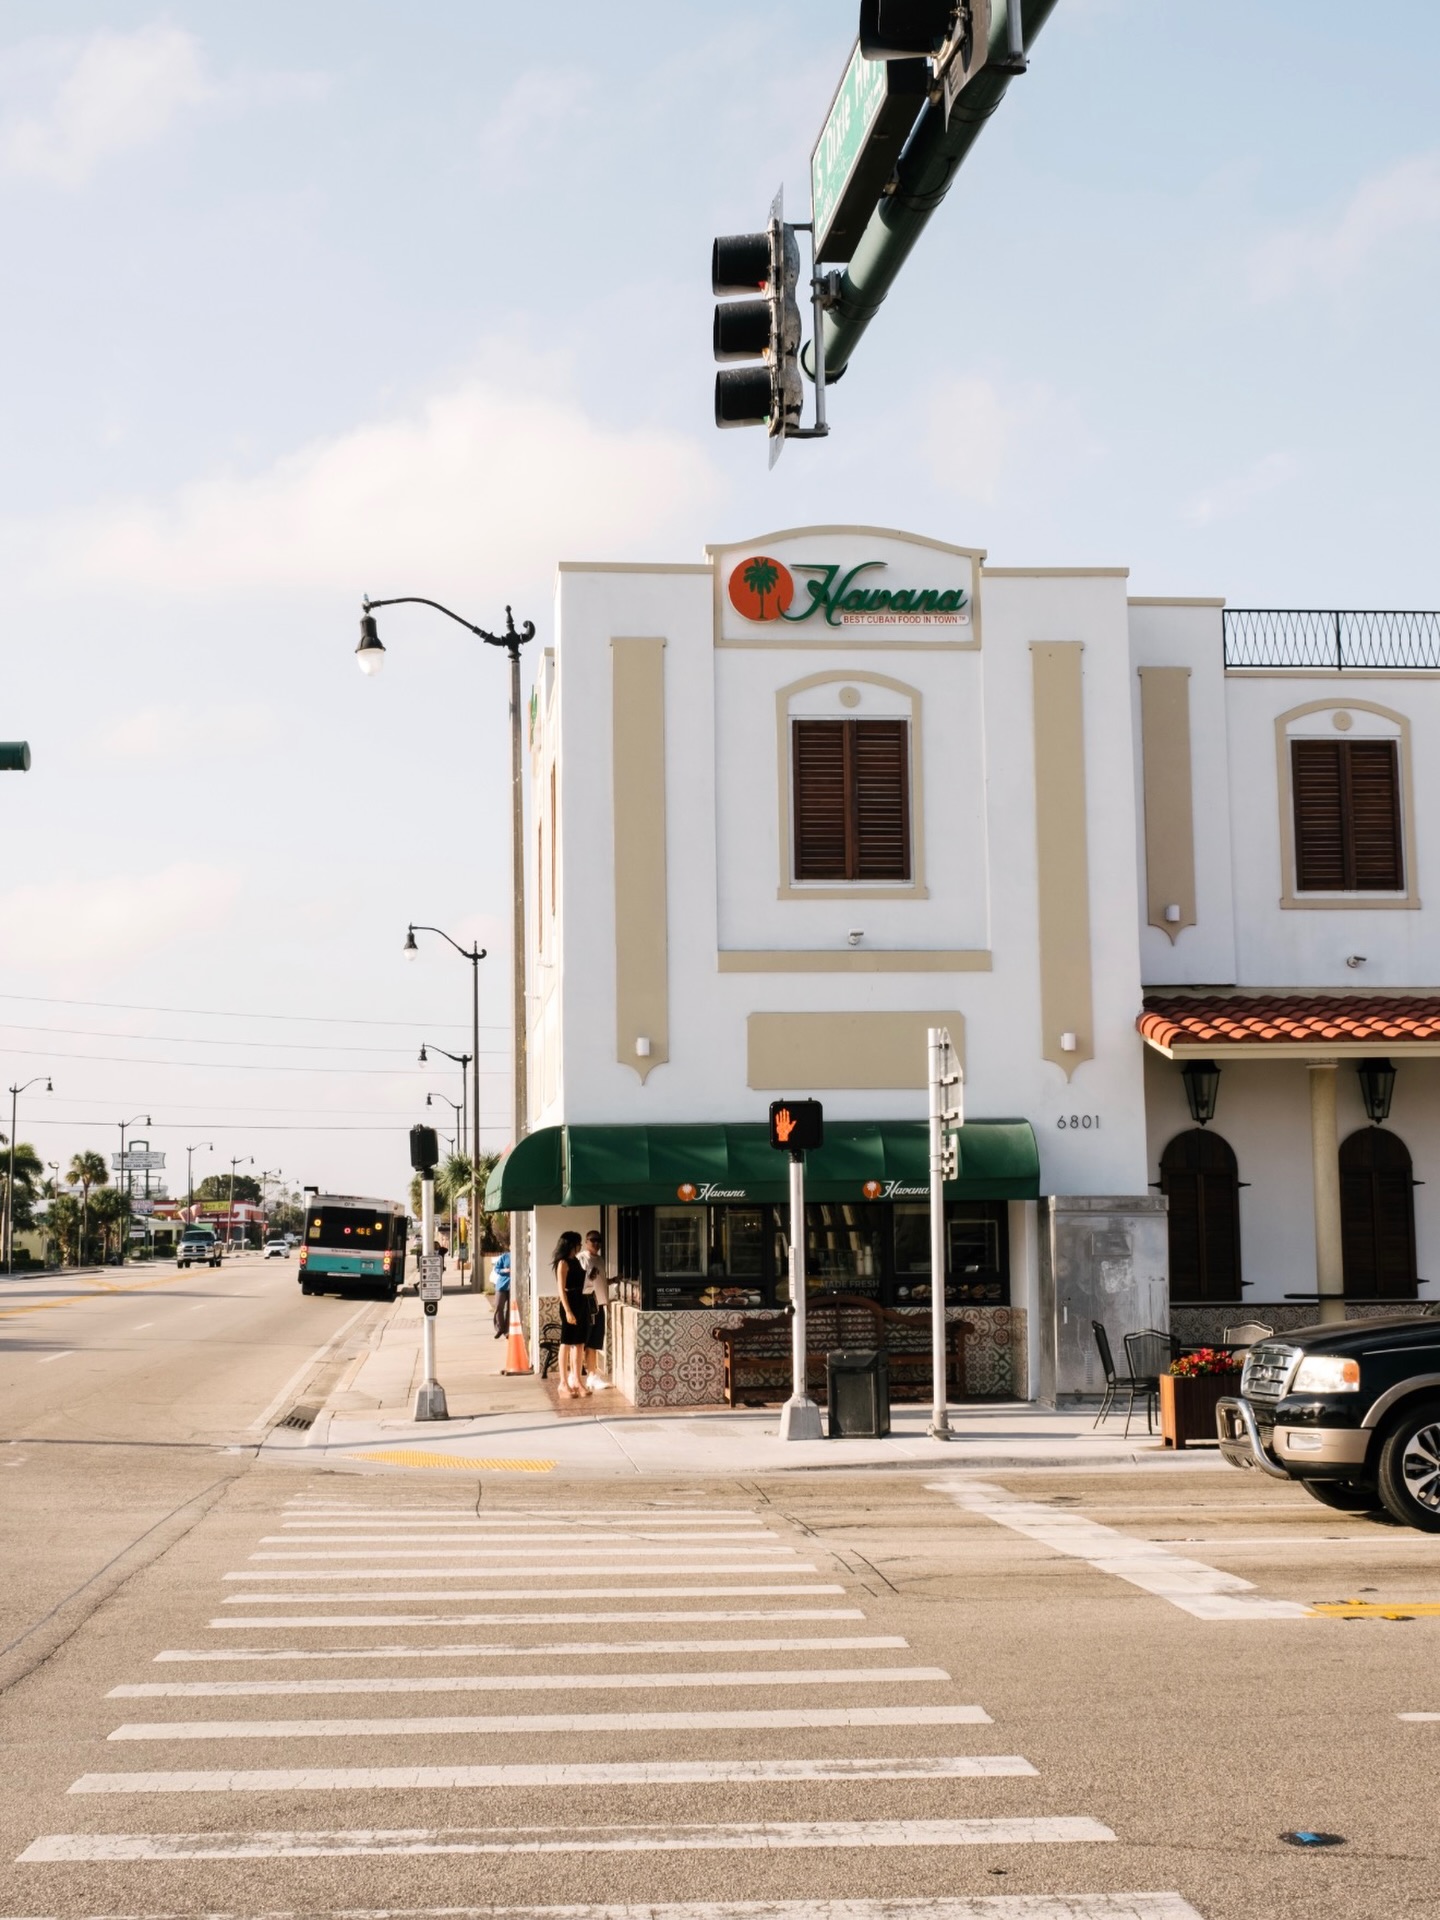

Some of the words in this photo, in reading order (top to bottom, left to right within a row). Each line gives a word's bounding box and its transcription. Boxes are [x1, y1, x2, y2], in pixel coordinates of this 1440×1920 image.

[816, 150, 823, 199] S
[826, 93, 851, 175] Dixie
[777, 561, 968, 628] Havana
[843, 615, 865, 624] BEST
[866, 615, 896, 624] CUBAN
[898, 615, 921, 624] FOOD
[923, 615, 931, 624] IN
[1057, 1115, 1100, 1129] 6801
[693, 1182, 746, 1201] Havana
[877, 1180, 930, 1199] Havana
[849, 1280, 880, 1288] FRESH
